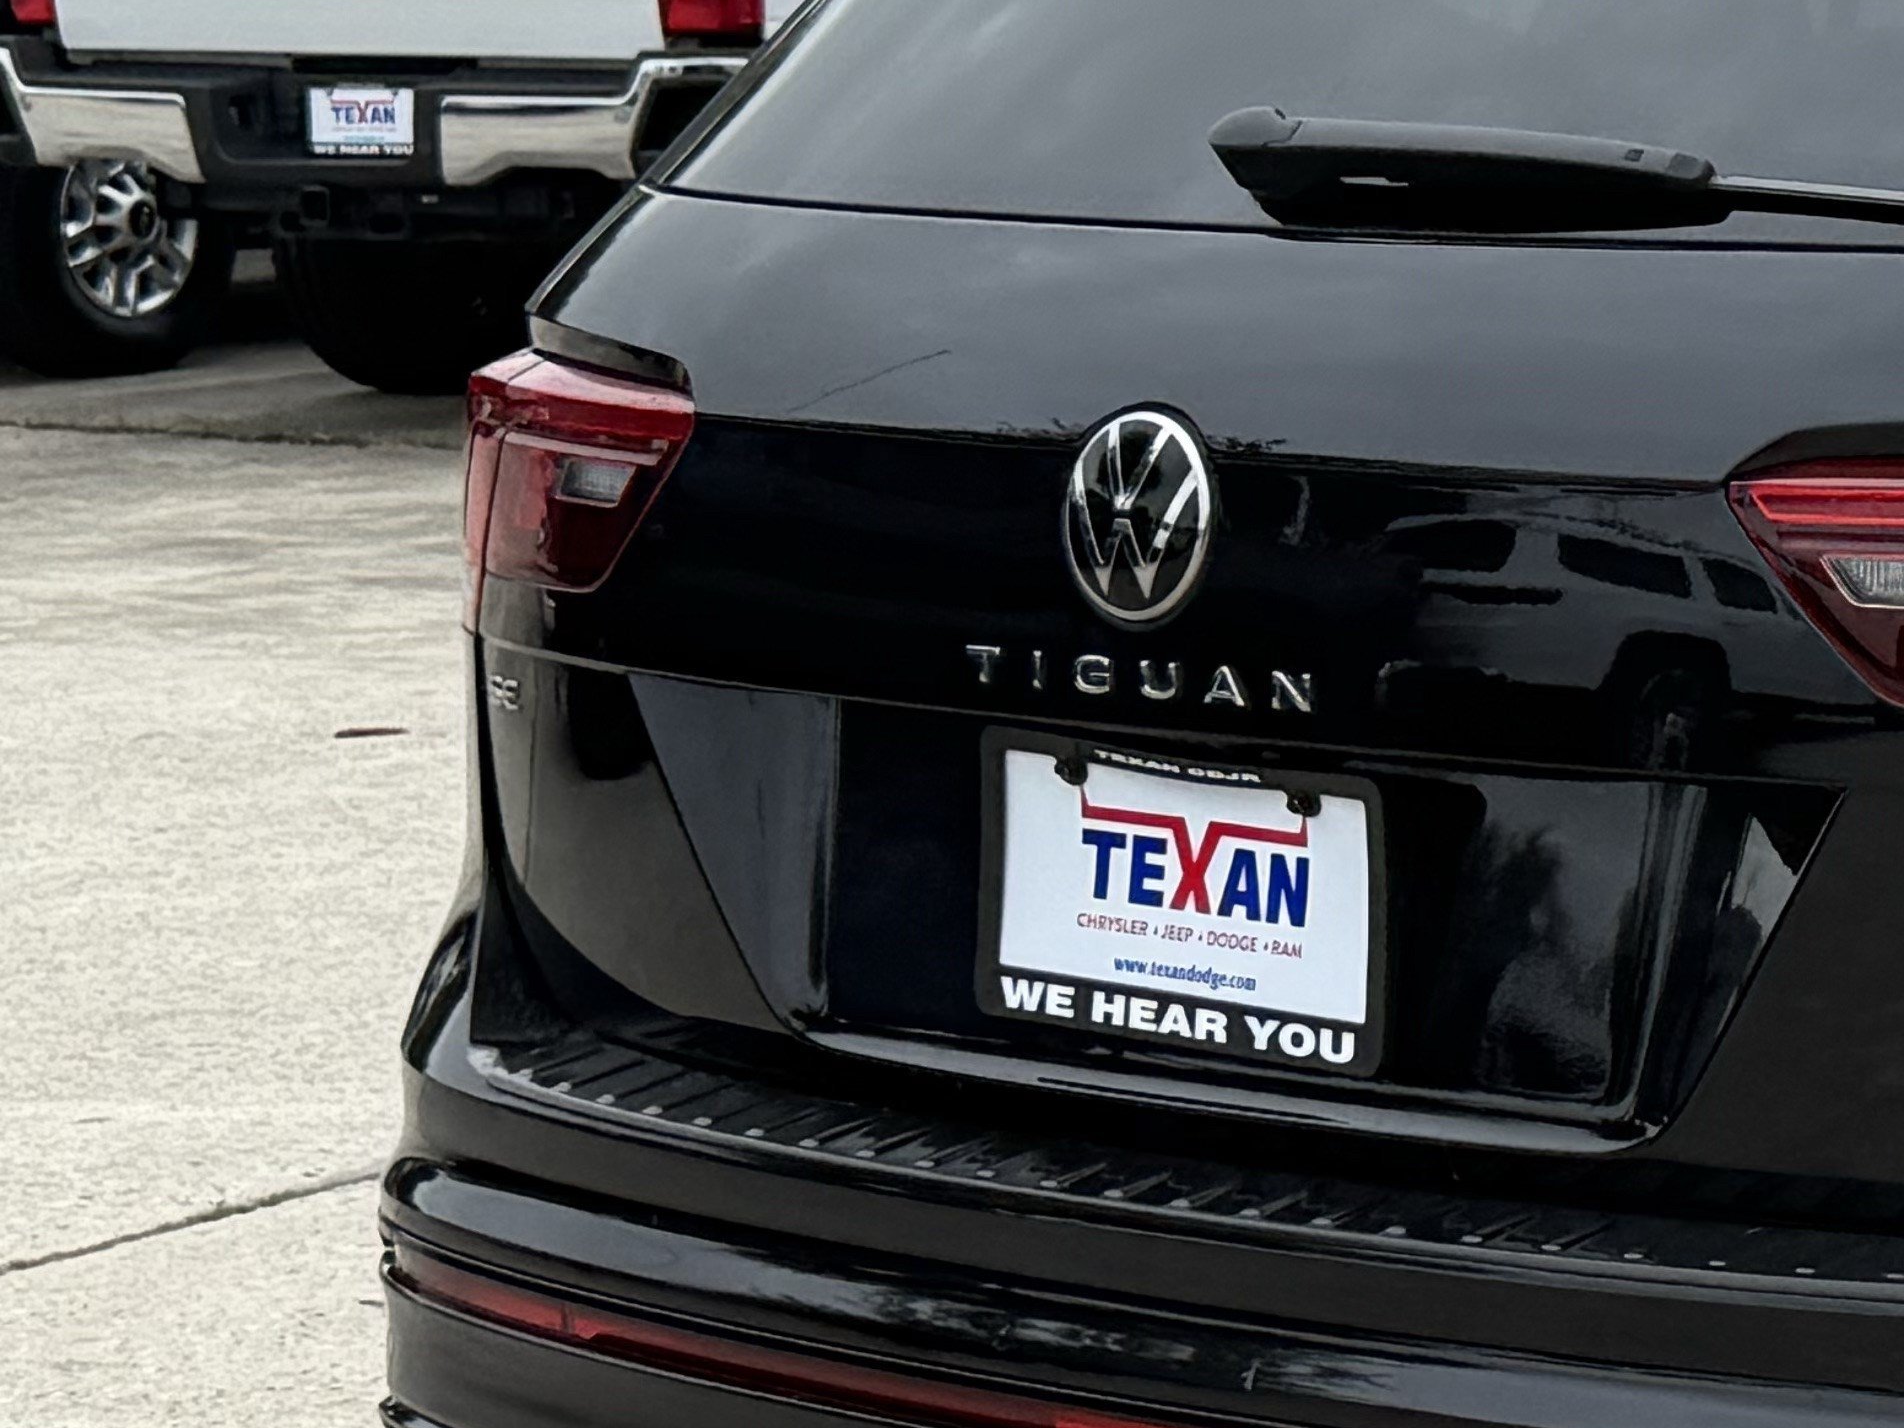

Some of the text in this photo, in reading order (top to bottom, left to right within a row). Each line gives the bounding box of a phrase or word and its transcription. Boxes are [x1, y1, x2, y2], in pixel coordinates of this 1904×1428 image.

[330, 100, 396, 125] TEXAN
[965, 644, 1313, 713] TIGUAN
[1082, 810, 1310, 928] TEXAN
[1076, 912, 1149, 936] CHRYSLER
[1160, 923, 1194, 943] JEEP
[1206, 930, 1259, 953] DODGE
[1113, 956, 1257, 991] www.texandodge.com
[1000, 975, 1356, 1064] WE HEAR YOU
